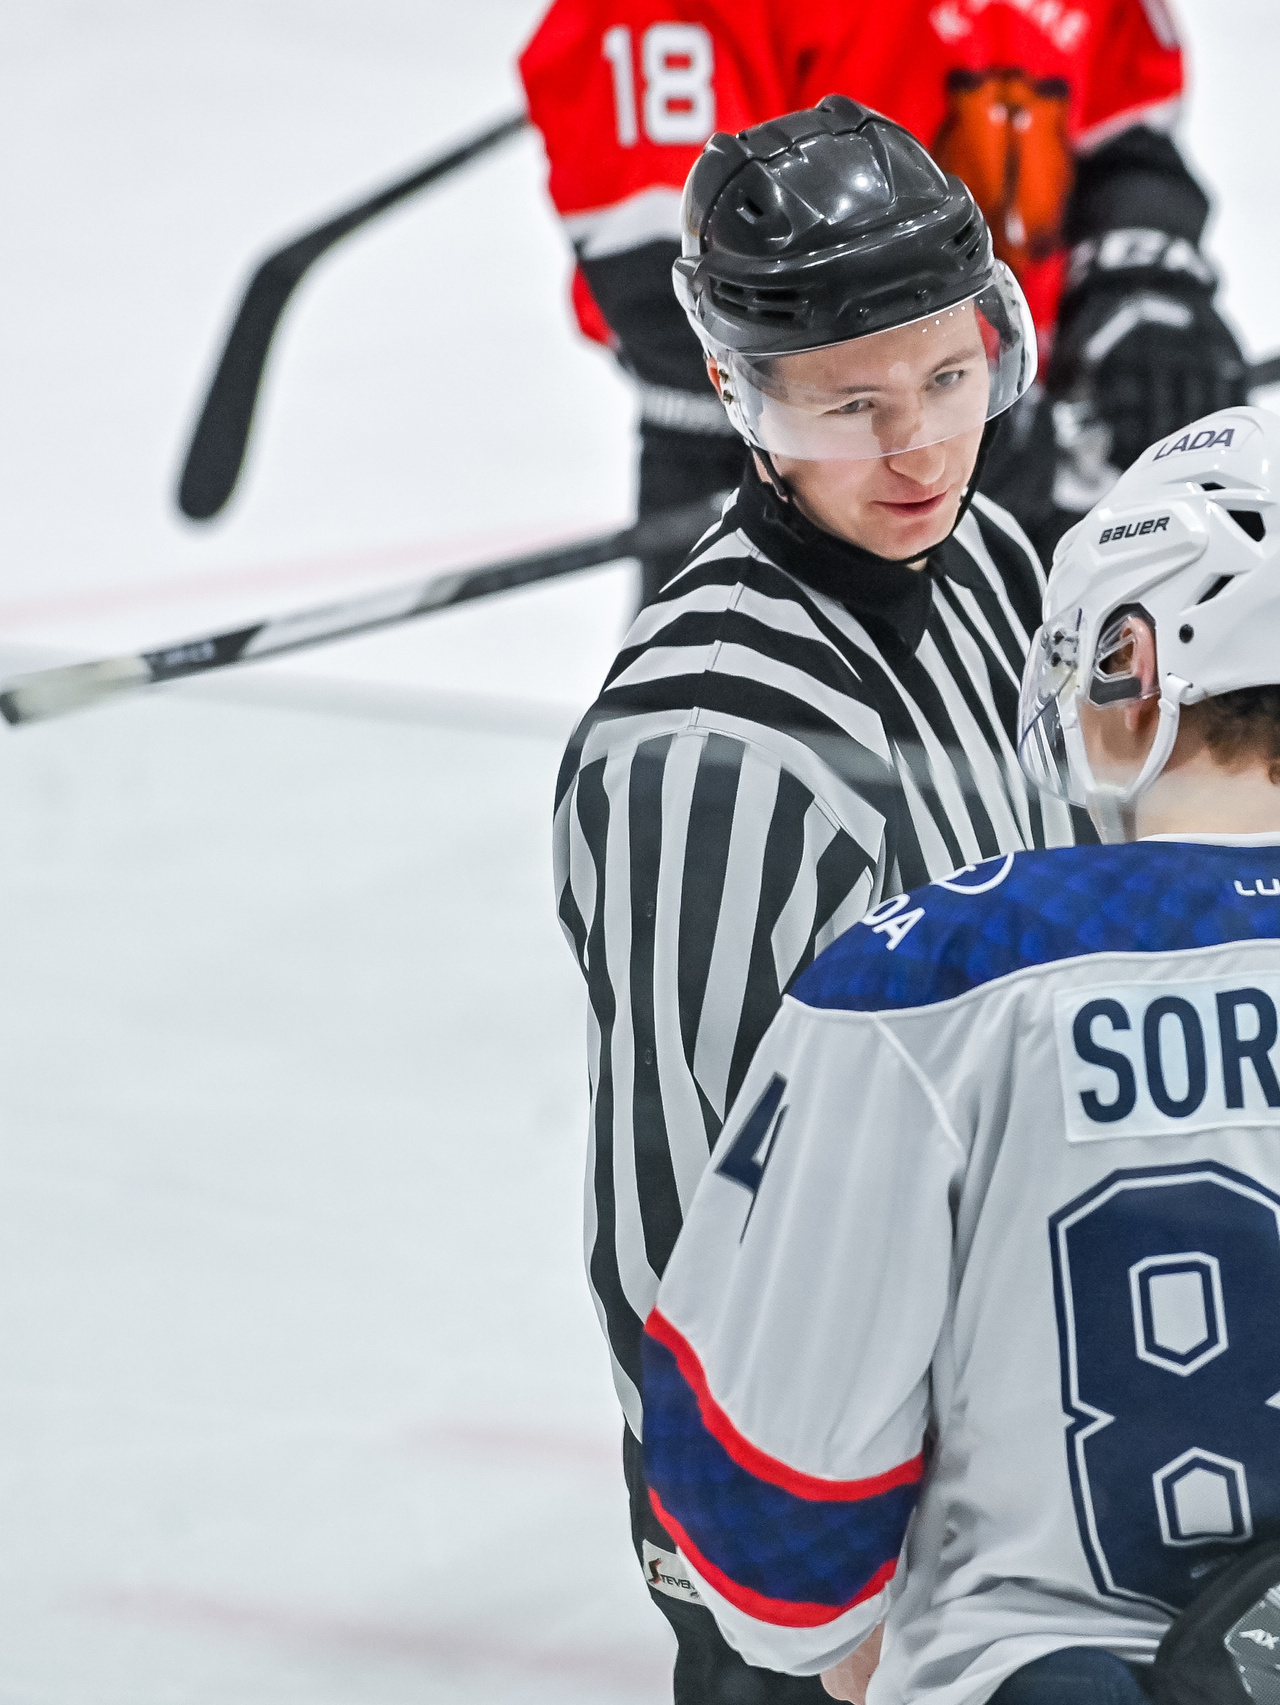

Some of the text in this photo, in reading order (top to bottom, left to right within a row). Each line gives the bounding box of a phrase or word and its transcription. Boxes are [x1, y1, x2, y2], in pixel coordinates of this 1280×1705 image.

[604, 23, 715, 147] 18
[1152, 428, 1235, 461] LADA
[1099, 516, 1170, 545] BAUER
